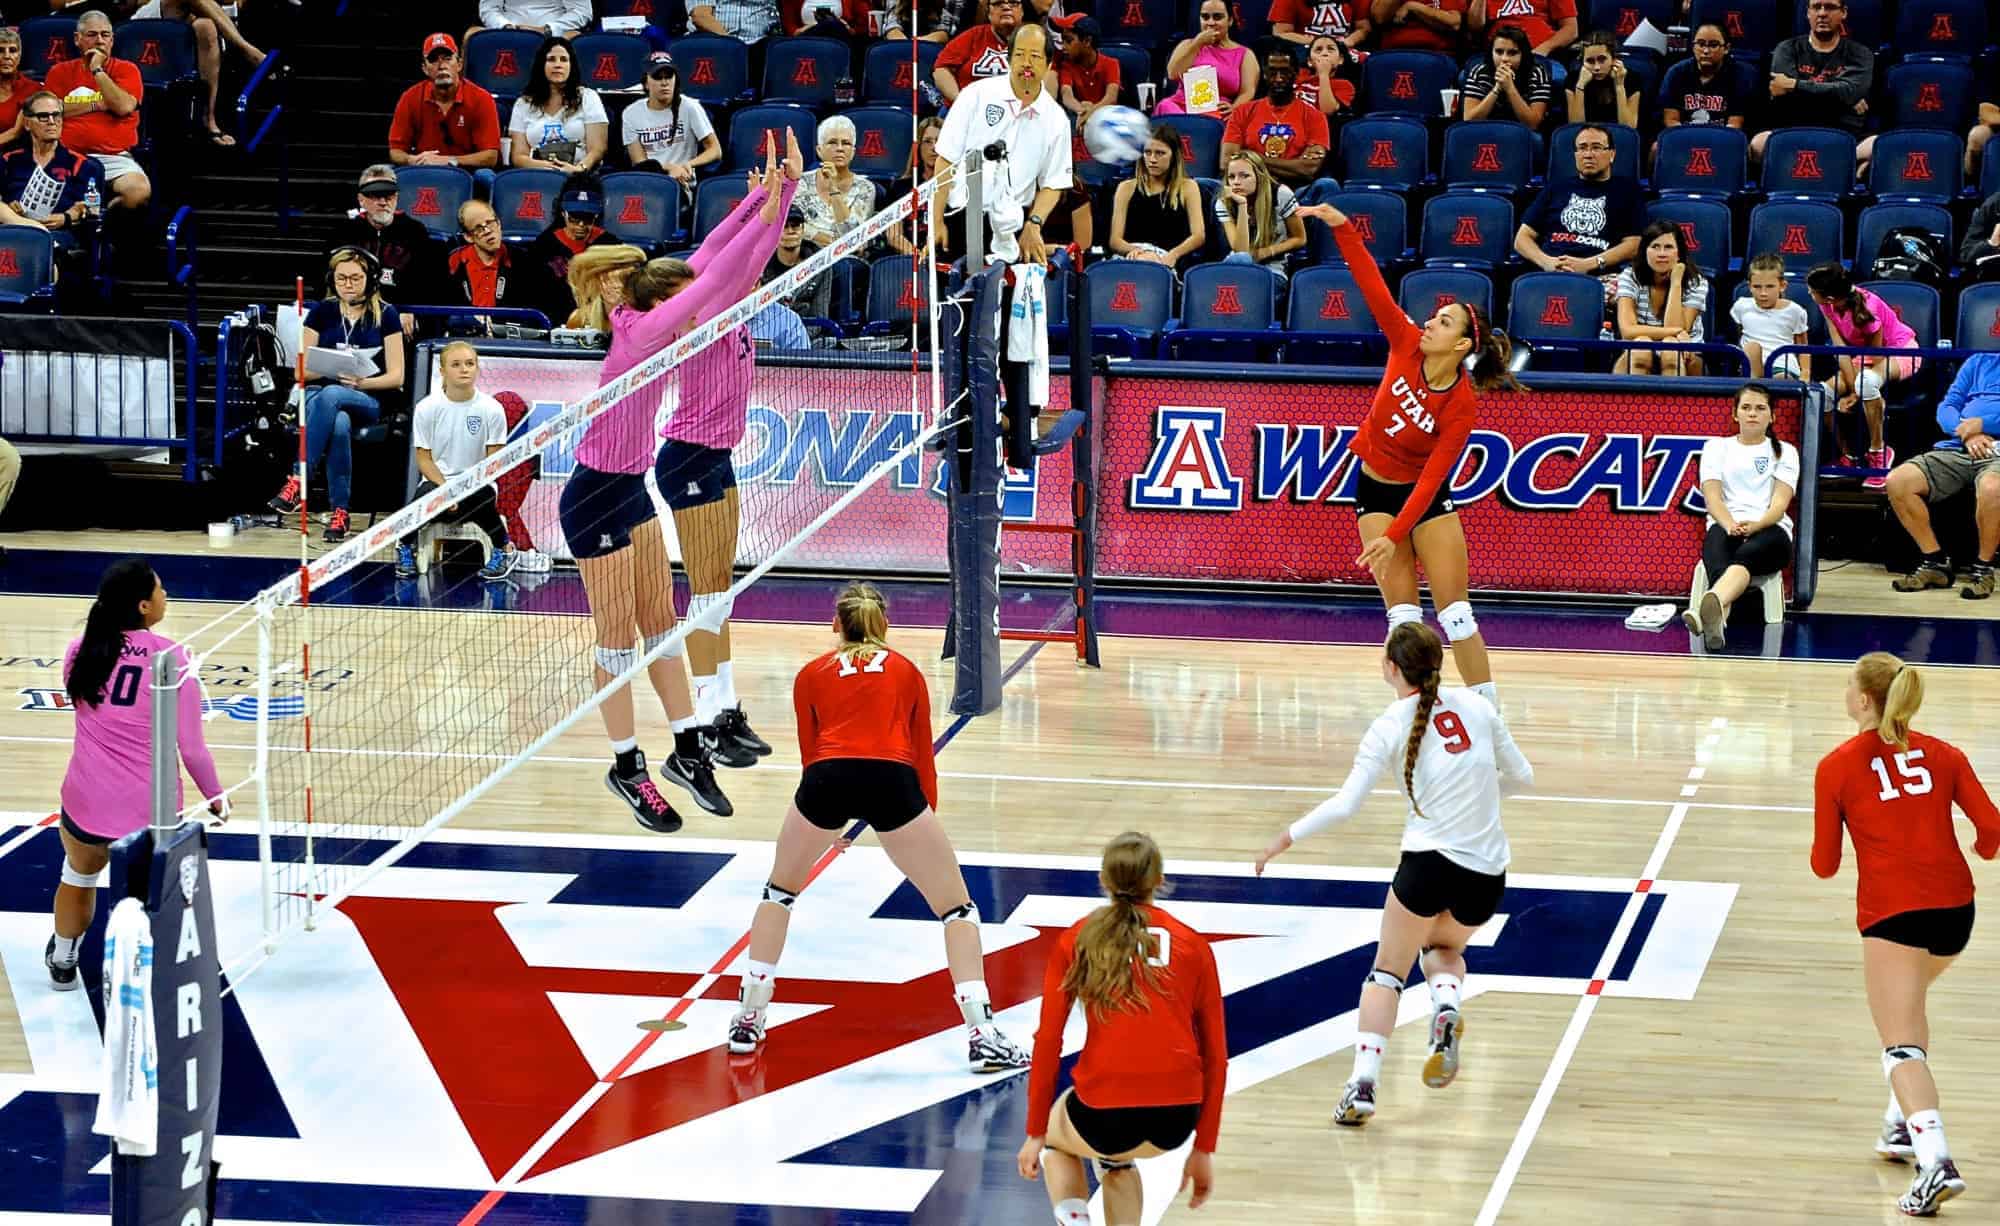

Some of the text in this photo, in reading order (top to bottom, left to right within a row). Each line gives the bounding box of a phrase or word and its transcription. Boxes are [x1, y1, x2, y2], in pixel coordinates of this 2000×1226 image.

[1685, 147, 1716, 175] A
[1791, 150, 1823, 178] A
[1902, 152, 1933, 180] A
[1452, 216, 1482, 245] A
[1780, 224, 1812, 253] A
[1110, 282, 1141, 311] A
[1211, 285, 1243, 315] A
[1320, 289, 1351, 319] A
[1539, 296, 1572, 326] A
[1391, 376, 1436, 433] UTAH
[1384, 413, 1407, 438] 7
[1131, 405, 1244, 511] A
[837, 649, 889, 678] 17
[1433, 709, 1472, 754] 9
[1870, 748, 1933, 801] 15
